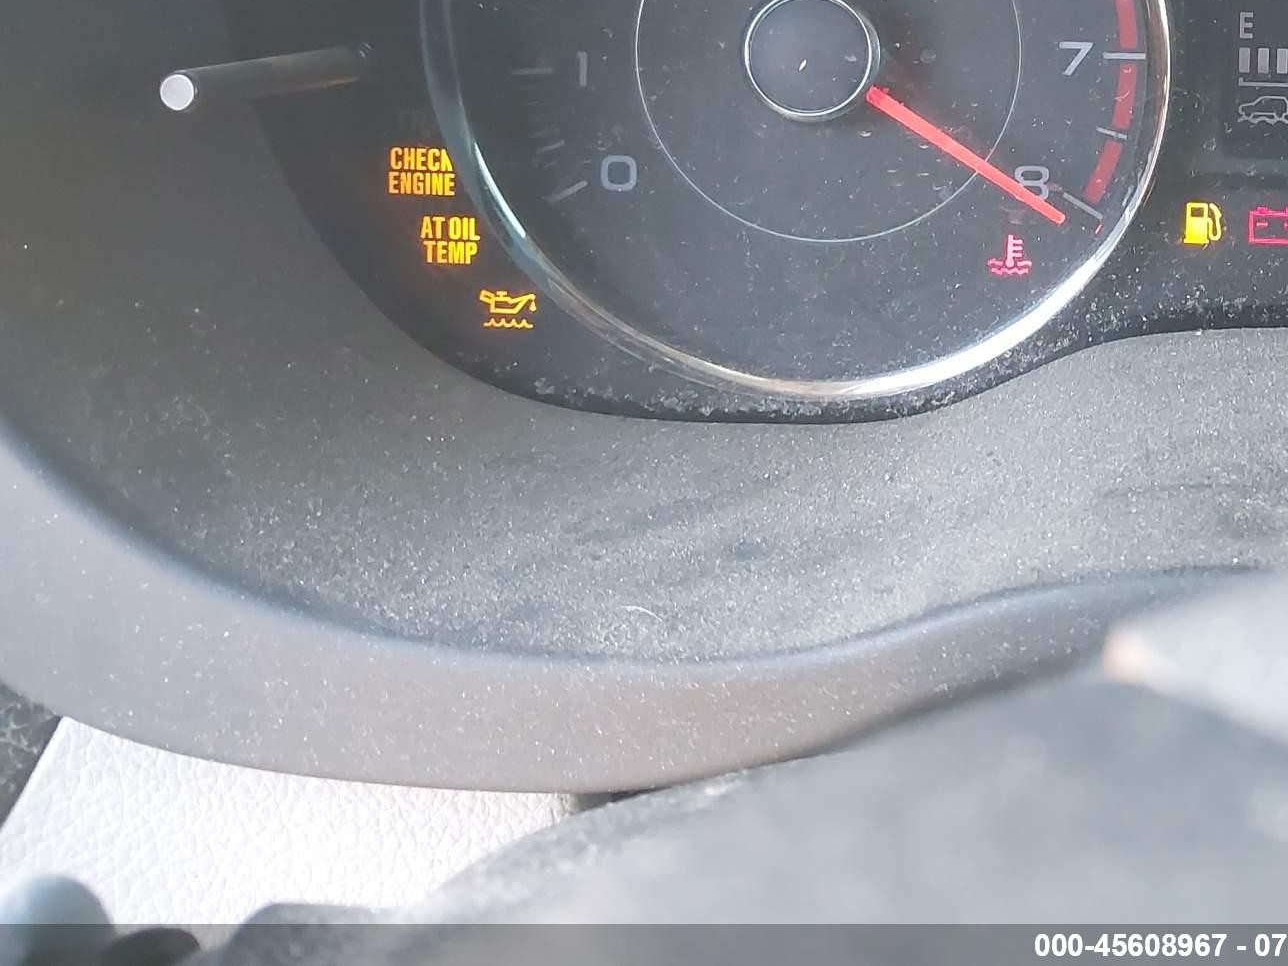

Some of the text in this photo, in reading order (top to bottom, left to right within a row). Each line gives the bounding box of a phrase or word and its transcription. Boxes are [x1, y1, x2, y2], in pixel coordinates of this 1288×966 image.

[1239, 11, 1254, 39] E
[577, 50, 588, 87] 1
[1058, 40, 1092, 75] 7
[387, 171, 456, 197] ENGINE
[600, 155, 638, 191] 0
[1014, 165, 1050, 201] 8
[420, 215, 481, 241] AT OIL
[422, 240, 479, 265] TEMP
